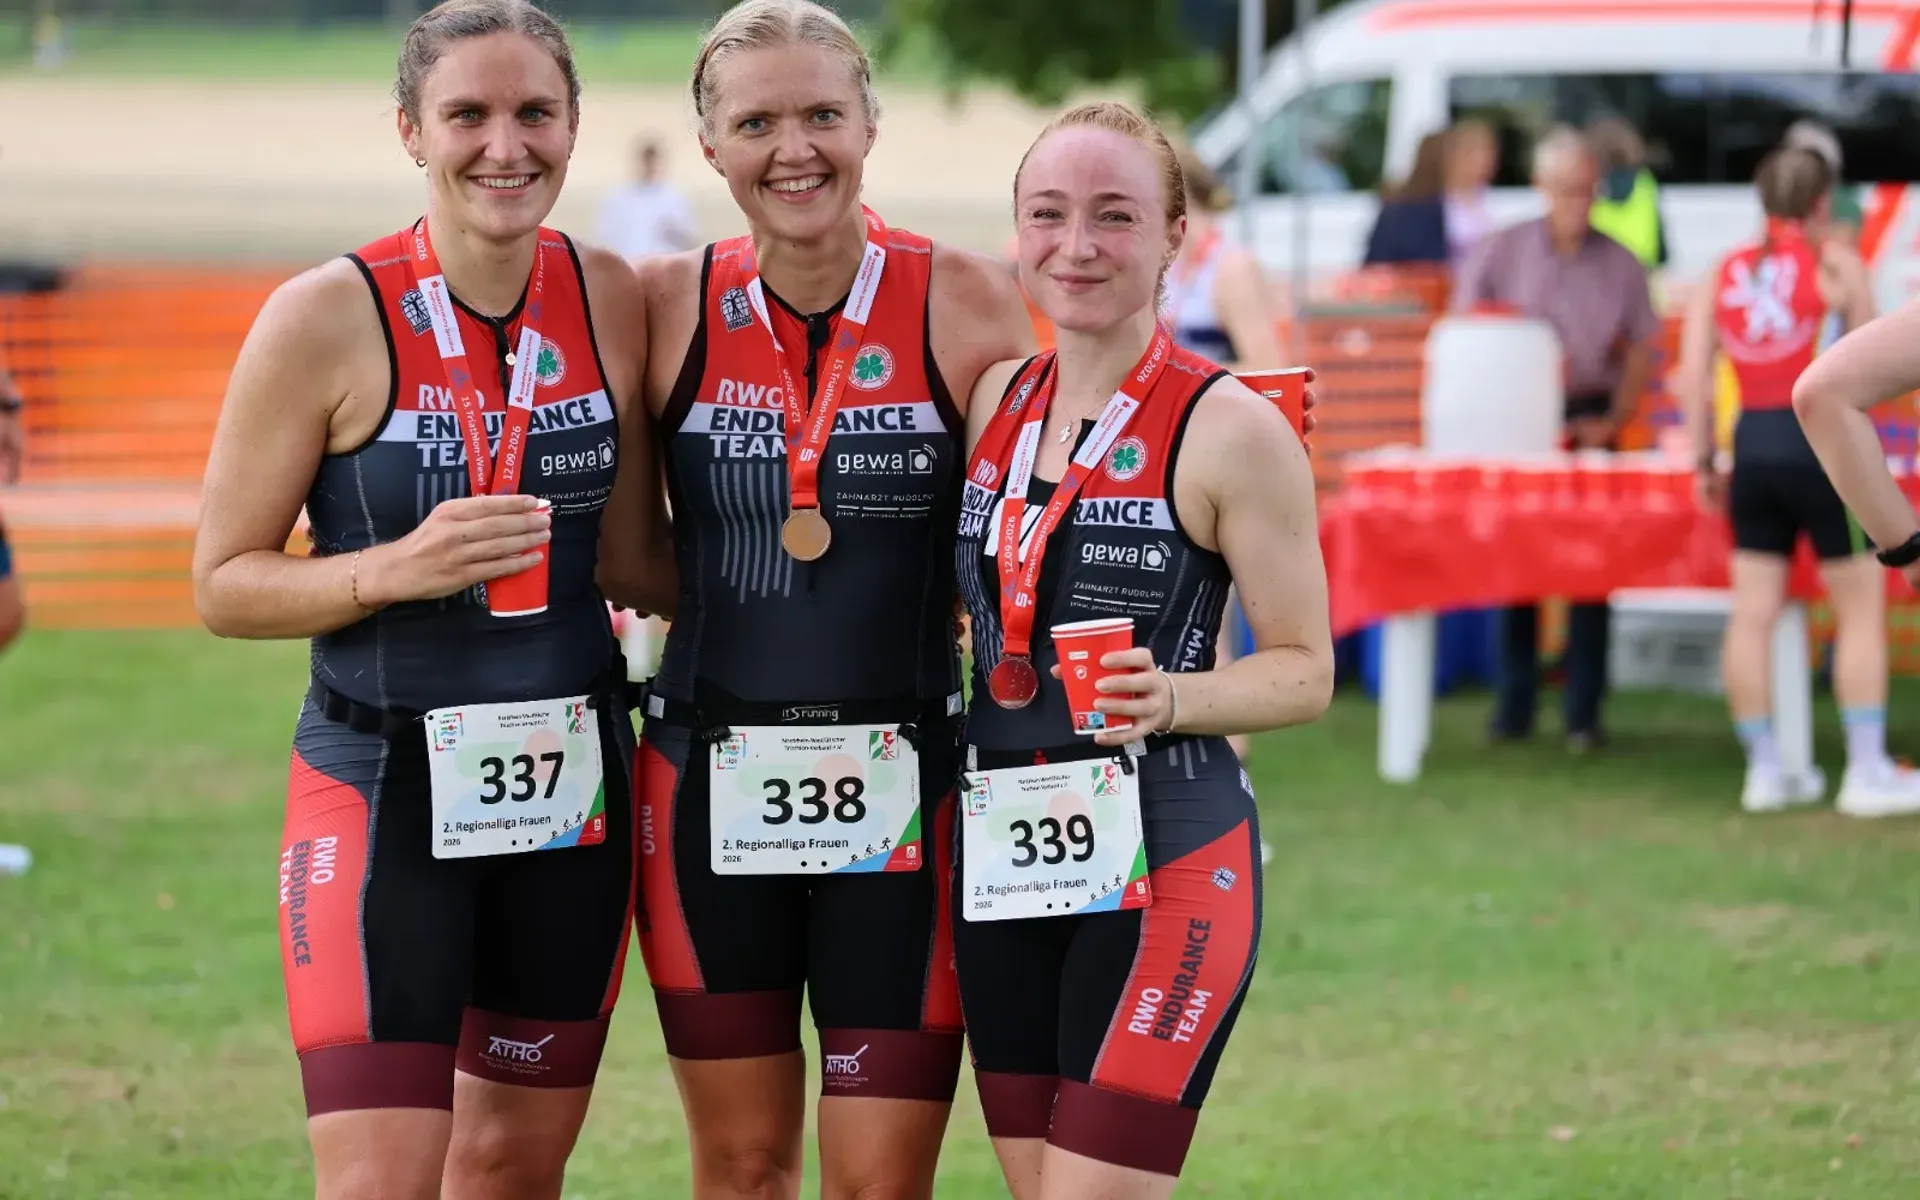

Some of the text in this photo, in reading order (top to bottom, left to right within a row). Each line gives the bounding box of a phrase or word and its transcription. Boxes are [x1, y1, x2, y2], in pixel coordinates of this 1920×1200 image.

[416, 397, 596, 439] ENUANCE
[710, 407, 916, 433] ENDANCE
[503, 425, 521, 480] 12.09.2026
[541, 450, 597, 476] gewa
[837, 453, 903, 474] gewa
[1004, 515, 1016, 575] 12.09.2026
[1081, 543, 1139, 564] gewa
[801, 709, 839, 721] running
[479, 751, 565, 805] 337
[762, 776, 866, 825] 338
[443, 814, 552, 834] 2. Regionalliga Frauen
[722, 837, 849, 851] 2. Regionalliga Frauen
[1009, 814, 1095, 868] 339
[280, 845, 293, 906] TEAM
[311, 836, 338, 885] RWO
[722, 855, 742, 863] 2026
[289, 839, 312, 968] ENDURANCE
[974, 877, 1088, 896] 2. Regionalliga Frauen
[1152, 917, 1212, 1042] ENDURANCE
[1128, 987, 1164, 1036] RWO
[1172, 988, 1213, 1045] TEAM
